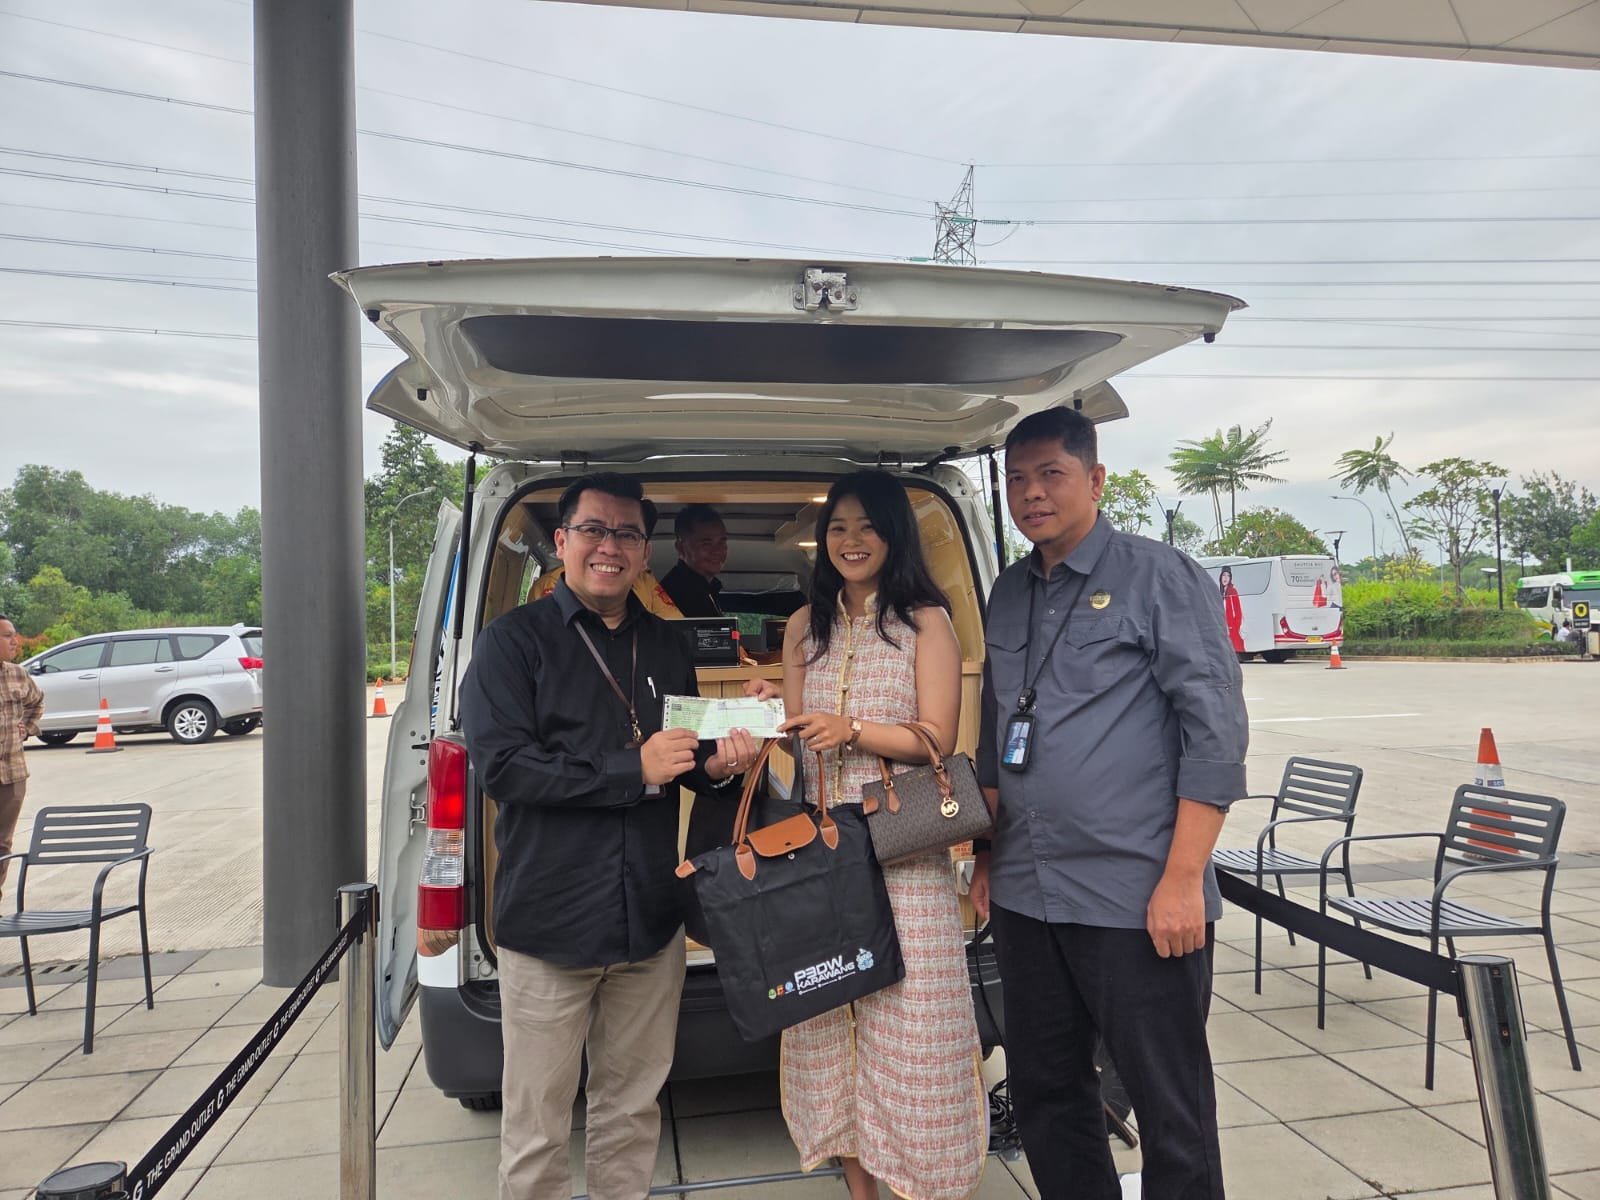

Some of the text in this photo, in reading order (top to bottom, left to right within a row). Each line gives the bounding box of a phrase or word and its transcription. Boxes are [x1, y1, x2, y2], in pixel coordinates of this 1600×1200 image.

[794, 955, 843, 984] P3DW
[797, 961, 855, 990] KARAWANG
[146, 1158, 164, 1189] THE
[164, 1129, 191, 1169] GRAND
[191, 1099, 216, 1138] OUTLET
[217, 1088, 225, 1110] G
[225, 1073, 238, 1097] THE
[237, 1052, 255, 1083] GRAND
[254, 1030, 274, 1060] OUTLET
[273, 1021, 280, 1039] G
